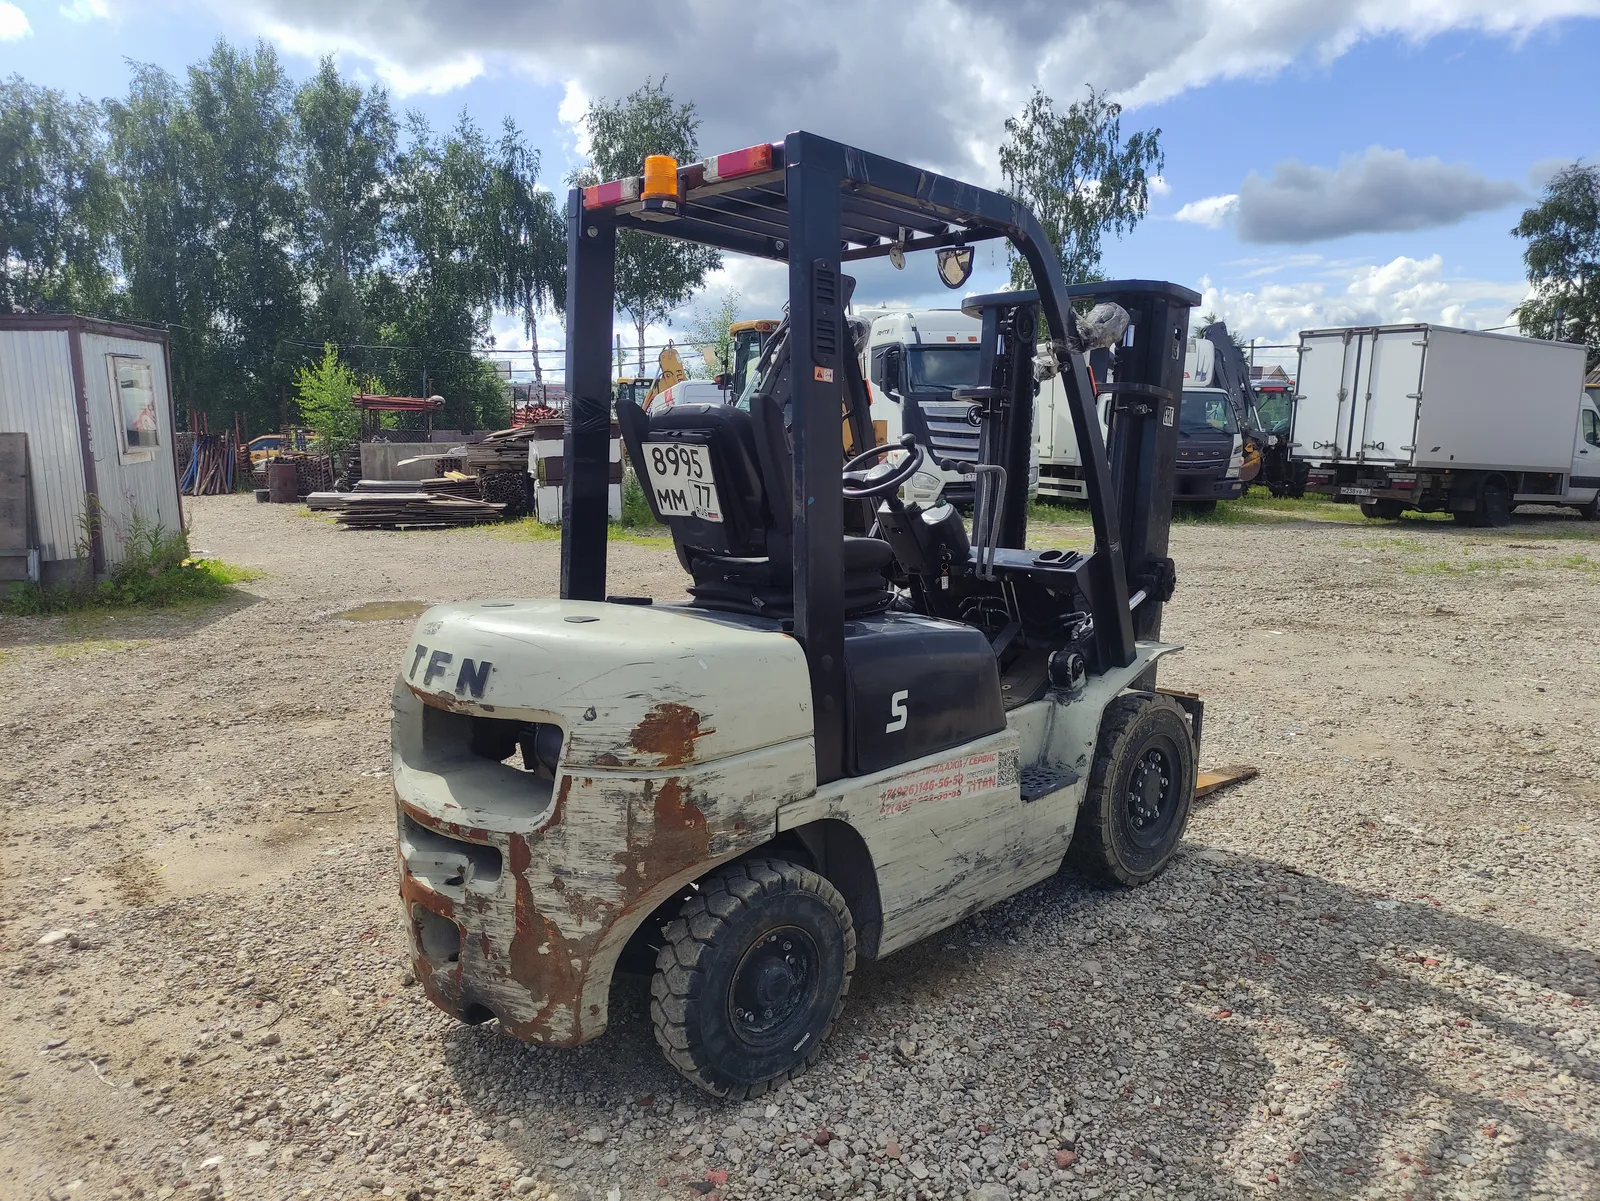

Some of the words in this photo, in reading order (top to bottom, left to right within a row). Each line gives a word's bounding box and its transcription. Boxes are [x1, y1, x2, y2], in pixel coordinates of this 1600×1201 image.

[652, 447, 703, 479] 8995
[657, 489, 689, 511] ММ
[694, 484, 711, 508] 77
[696, 506, 708, 517] RUS
[409, 644, 493, 699] TFN
